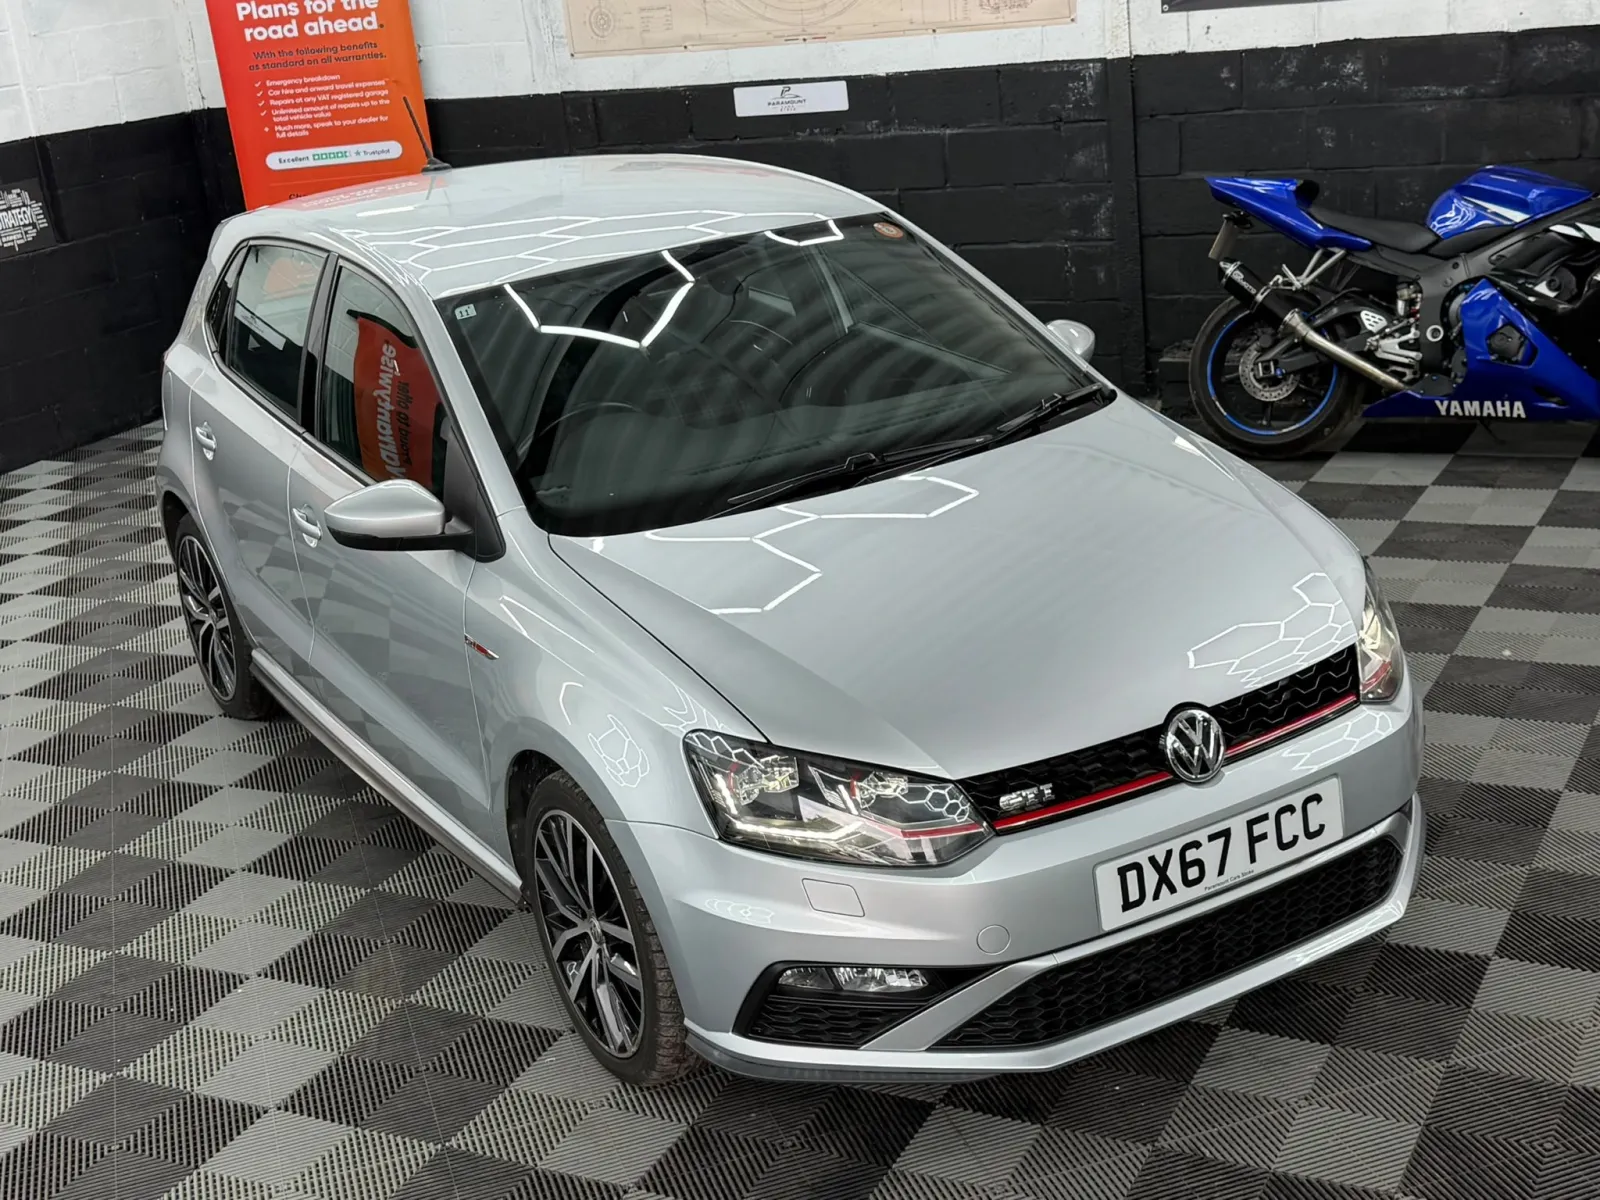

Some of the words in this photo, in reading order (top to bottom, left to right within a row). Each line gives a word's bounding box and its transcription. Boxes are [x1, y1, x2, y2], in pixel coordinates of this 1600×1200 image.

[235, 0, 300, 21] Plans
[304, 0, 336, 14] for
[342, 0, 379, 11] the
[243, 18, 299, 42] road
[303, 11, 385, 36] ahead.
[253, 50, 276, 60] With
[278, 49, 294, 58] the
[296, 45, 339, 56] following
[340, 41, 378, 52] benefits
[248, 63, 260, 71] as
[262, 58, 305, 70] standard
[306, 58, 319, 66] on
[320, 55, 333, 64] all
[334, 51, 387, 63] warranties.
[266, 78, 303, 87] Emergency
[303, 74, 341, 83] breakdown
[295, 86, 309, 94] and
[309, 84, 334, 92] onward
[335, 81, 355, 89] travel
[269, 98, 295, 106] Repairs
[331, 91, 364, 101] registered
[365, 89, 389, 98] garage
[767, 98, 807, 107] PARAMOUNT
[271, 107, 303, 116] Unlimited
[338, 102, 360, 110] repairs
[289, 113, 313, 121] vehicle
[313, 120, 333, 129] speak
[342, 119, 357, 127] your
[357, 116, 379, 124] dealer
[276, 131, 287, 139] full
[287, 130, 310, 138] details
[278, 155, 310, 165] Excellent
[362, 148, 391, 158] Trustpilot
[1434, 399, 1527, 419] YAMAHA
[1116, 826, 1233, 913] DX67
[1246, 792, 1327, 865] FCC
[1204, 879, 1230, 891] Paramount
